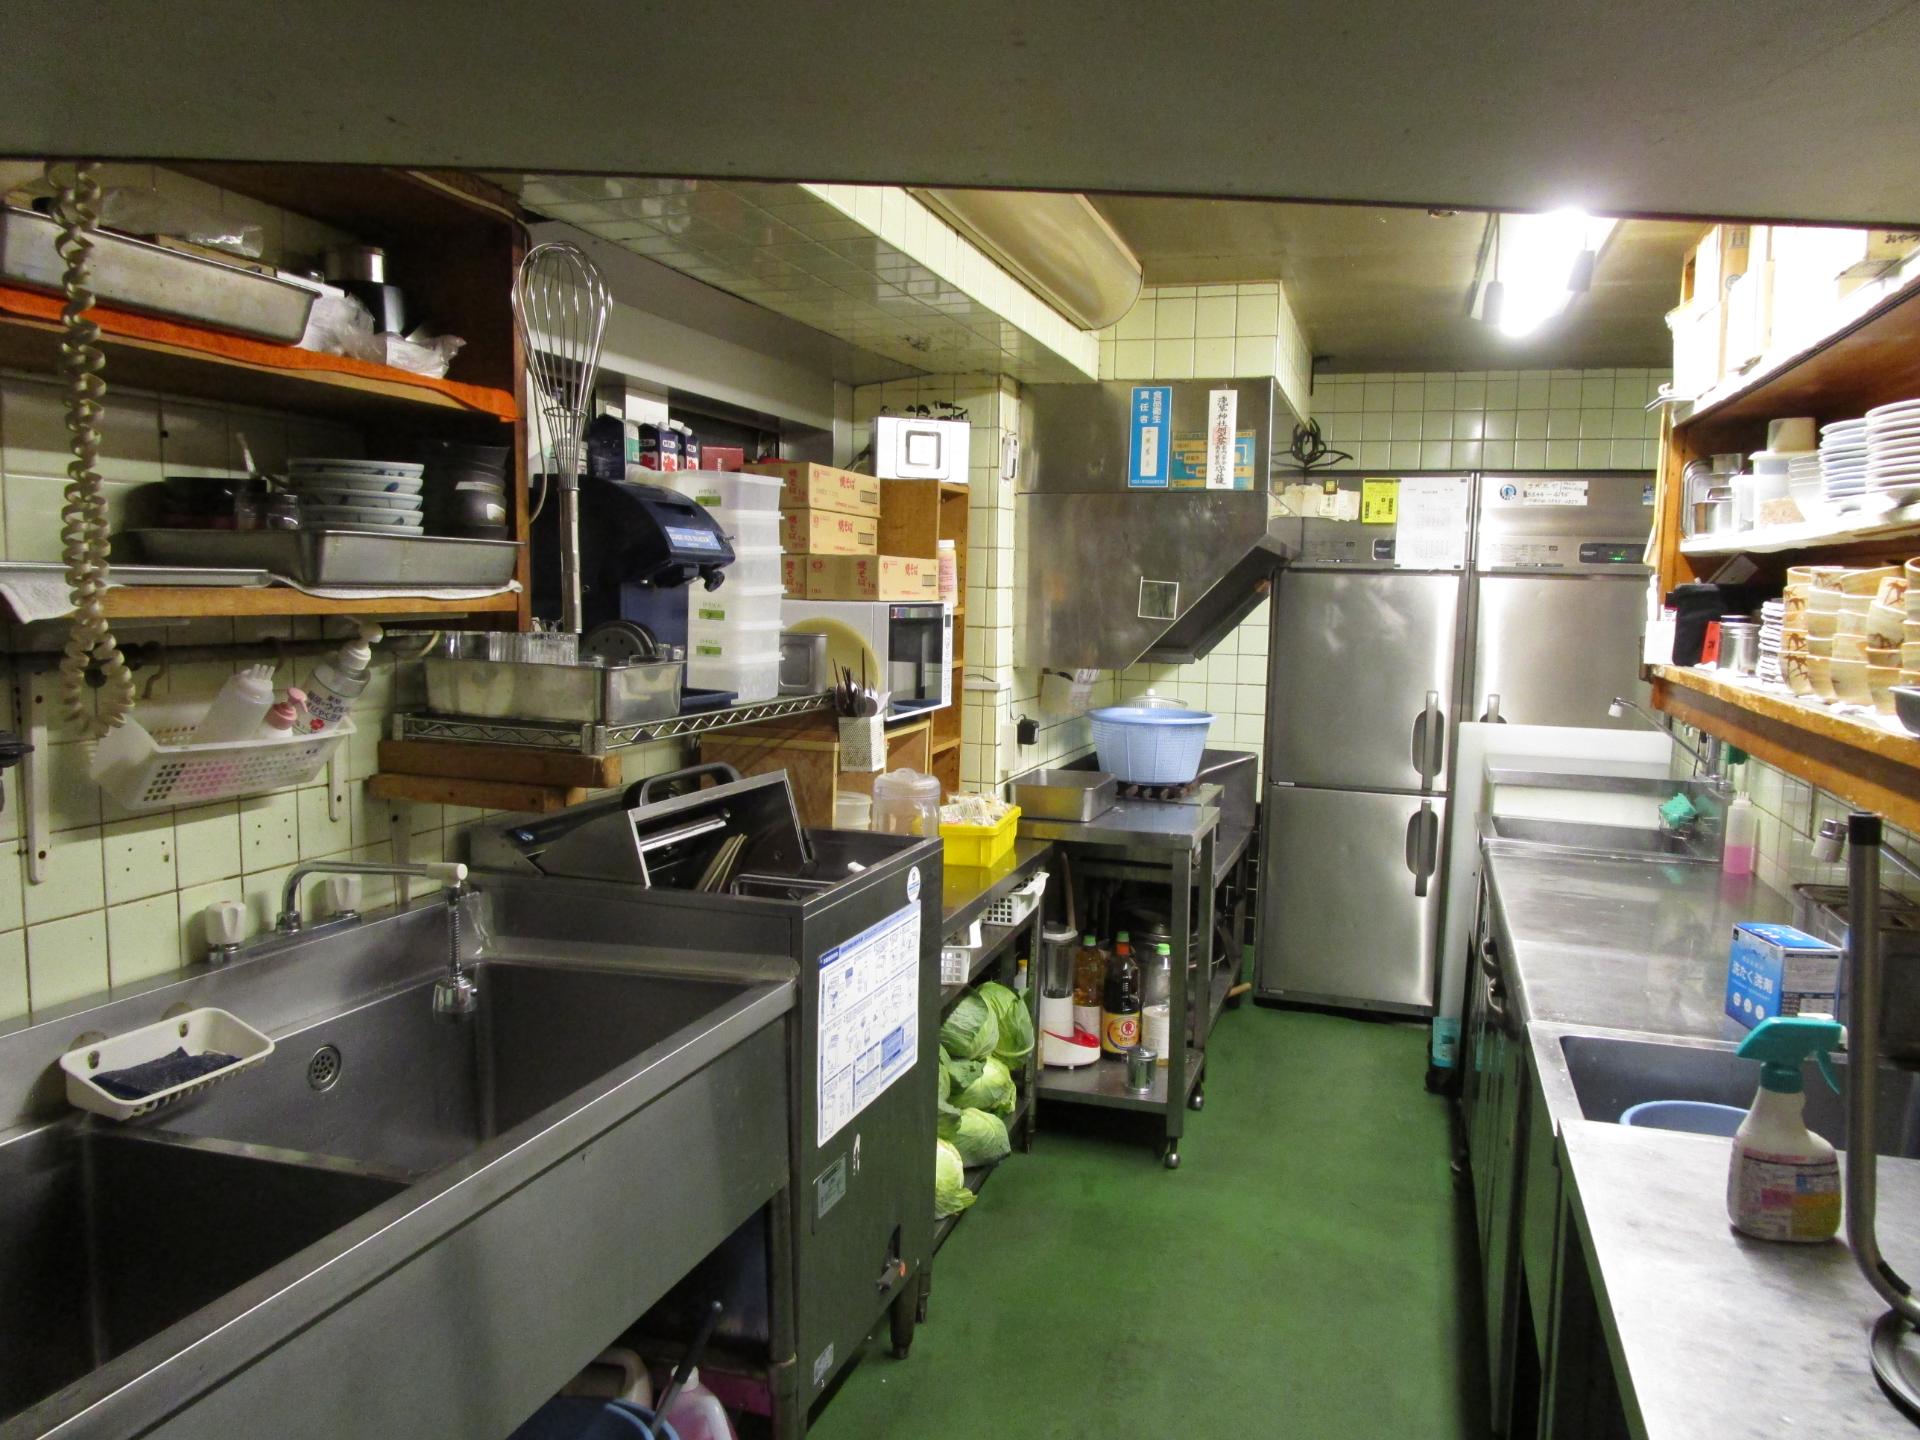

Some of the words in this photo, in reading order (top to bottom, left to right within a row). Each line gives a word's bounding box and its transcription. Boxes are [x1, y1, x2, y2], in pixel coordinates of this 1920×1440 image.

[1140, 391, 1149, 423] 責任者
[838, 475, 856, 490] 焼そば
[837, 519, 854, 534] 焼そば
[904, 562, 919, 577] 焼そば
[1732, 961, 1774, 994] 洗たく洗剤
